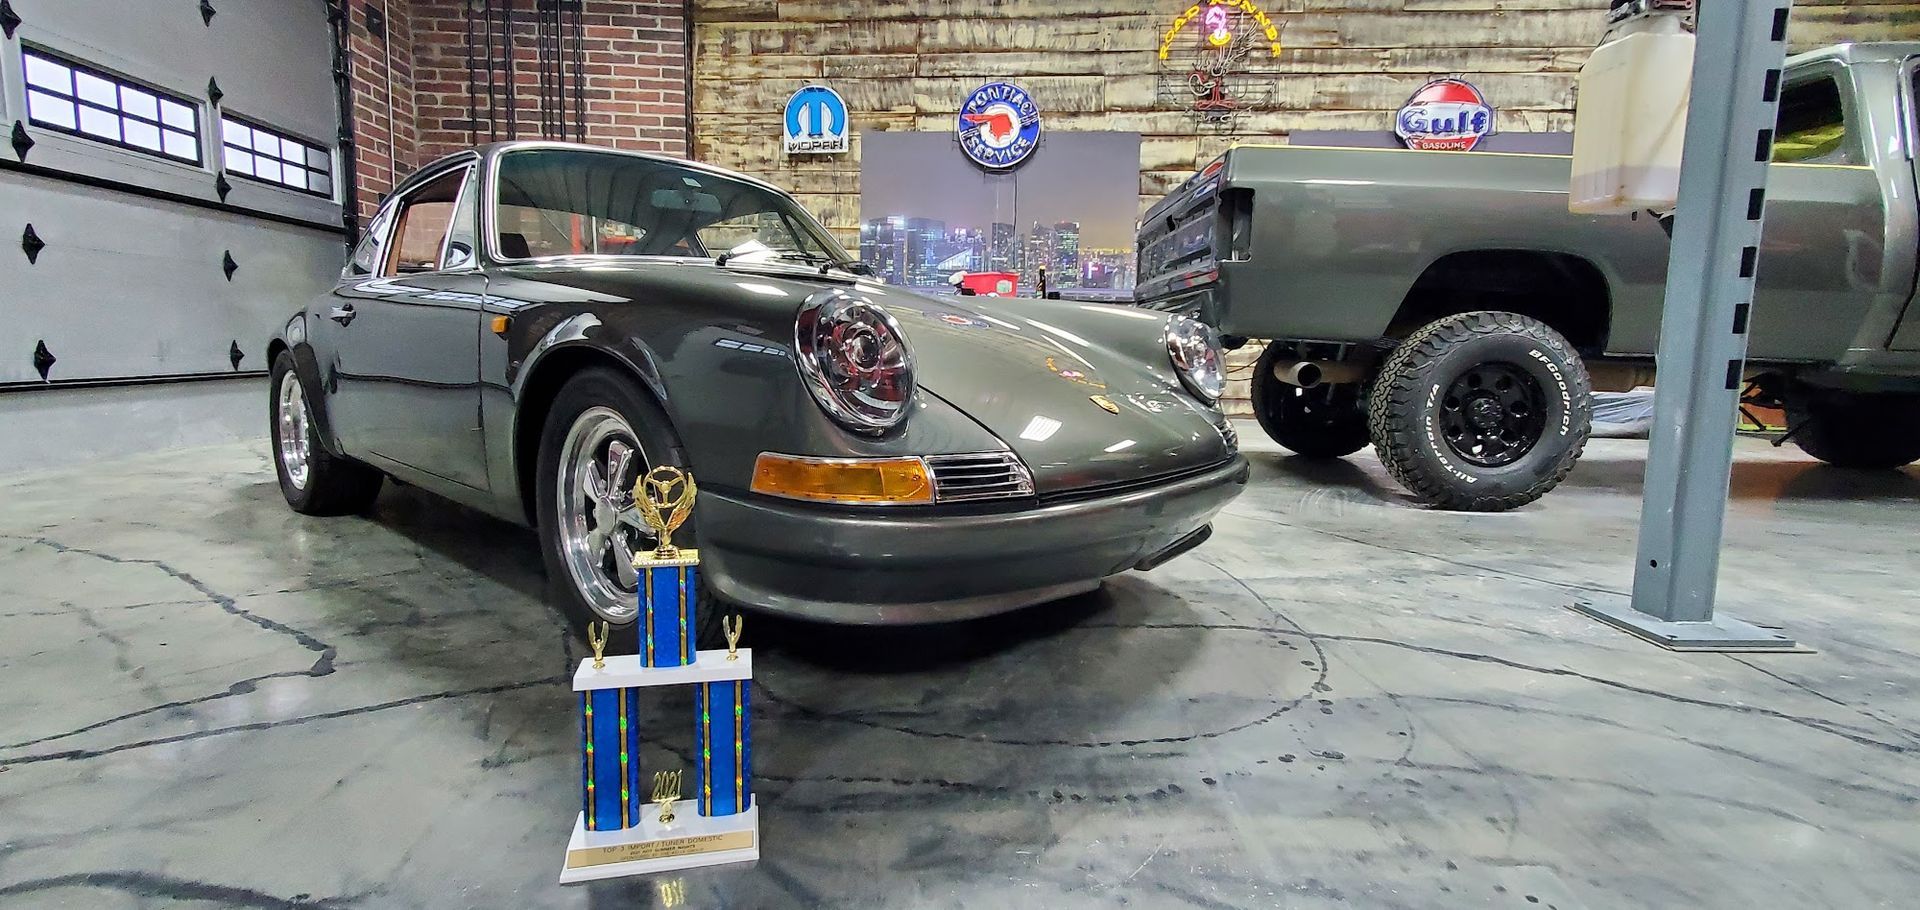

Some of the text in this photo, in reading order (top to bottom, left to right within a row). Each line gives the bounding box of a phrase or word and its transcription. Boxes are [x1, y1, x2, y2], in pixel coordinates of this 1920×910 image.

[1159, 5, 1200, 60] ROAD
[967, 86, 1034, 115] PONTIAC
[1401, 108, 1488, 135] Gulf
[788, 138, 844, 152] MOPAR
[966, 136, 1031, 162] SERVICE
[1422, 141, 1467, 150] GASOLINE
[1425, 383, 1440, 410] T/A
[1528, 349, 1572, 437] BFGoodrich
[652, 770, 683, 800] 2021
[629, 843, 655, 851] IMPORT
[661, 839, 684, 848] TUNER
[687, 834, 723, 844] DOMESTIC
